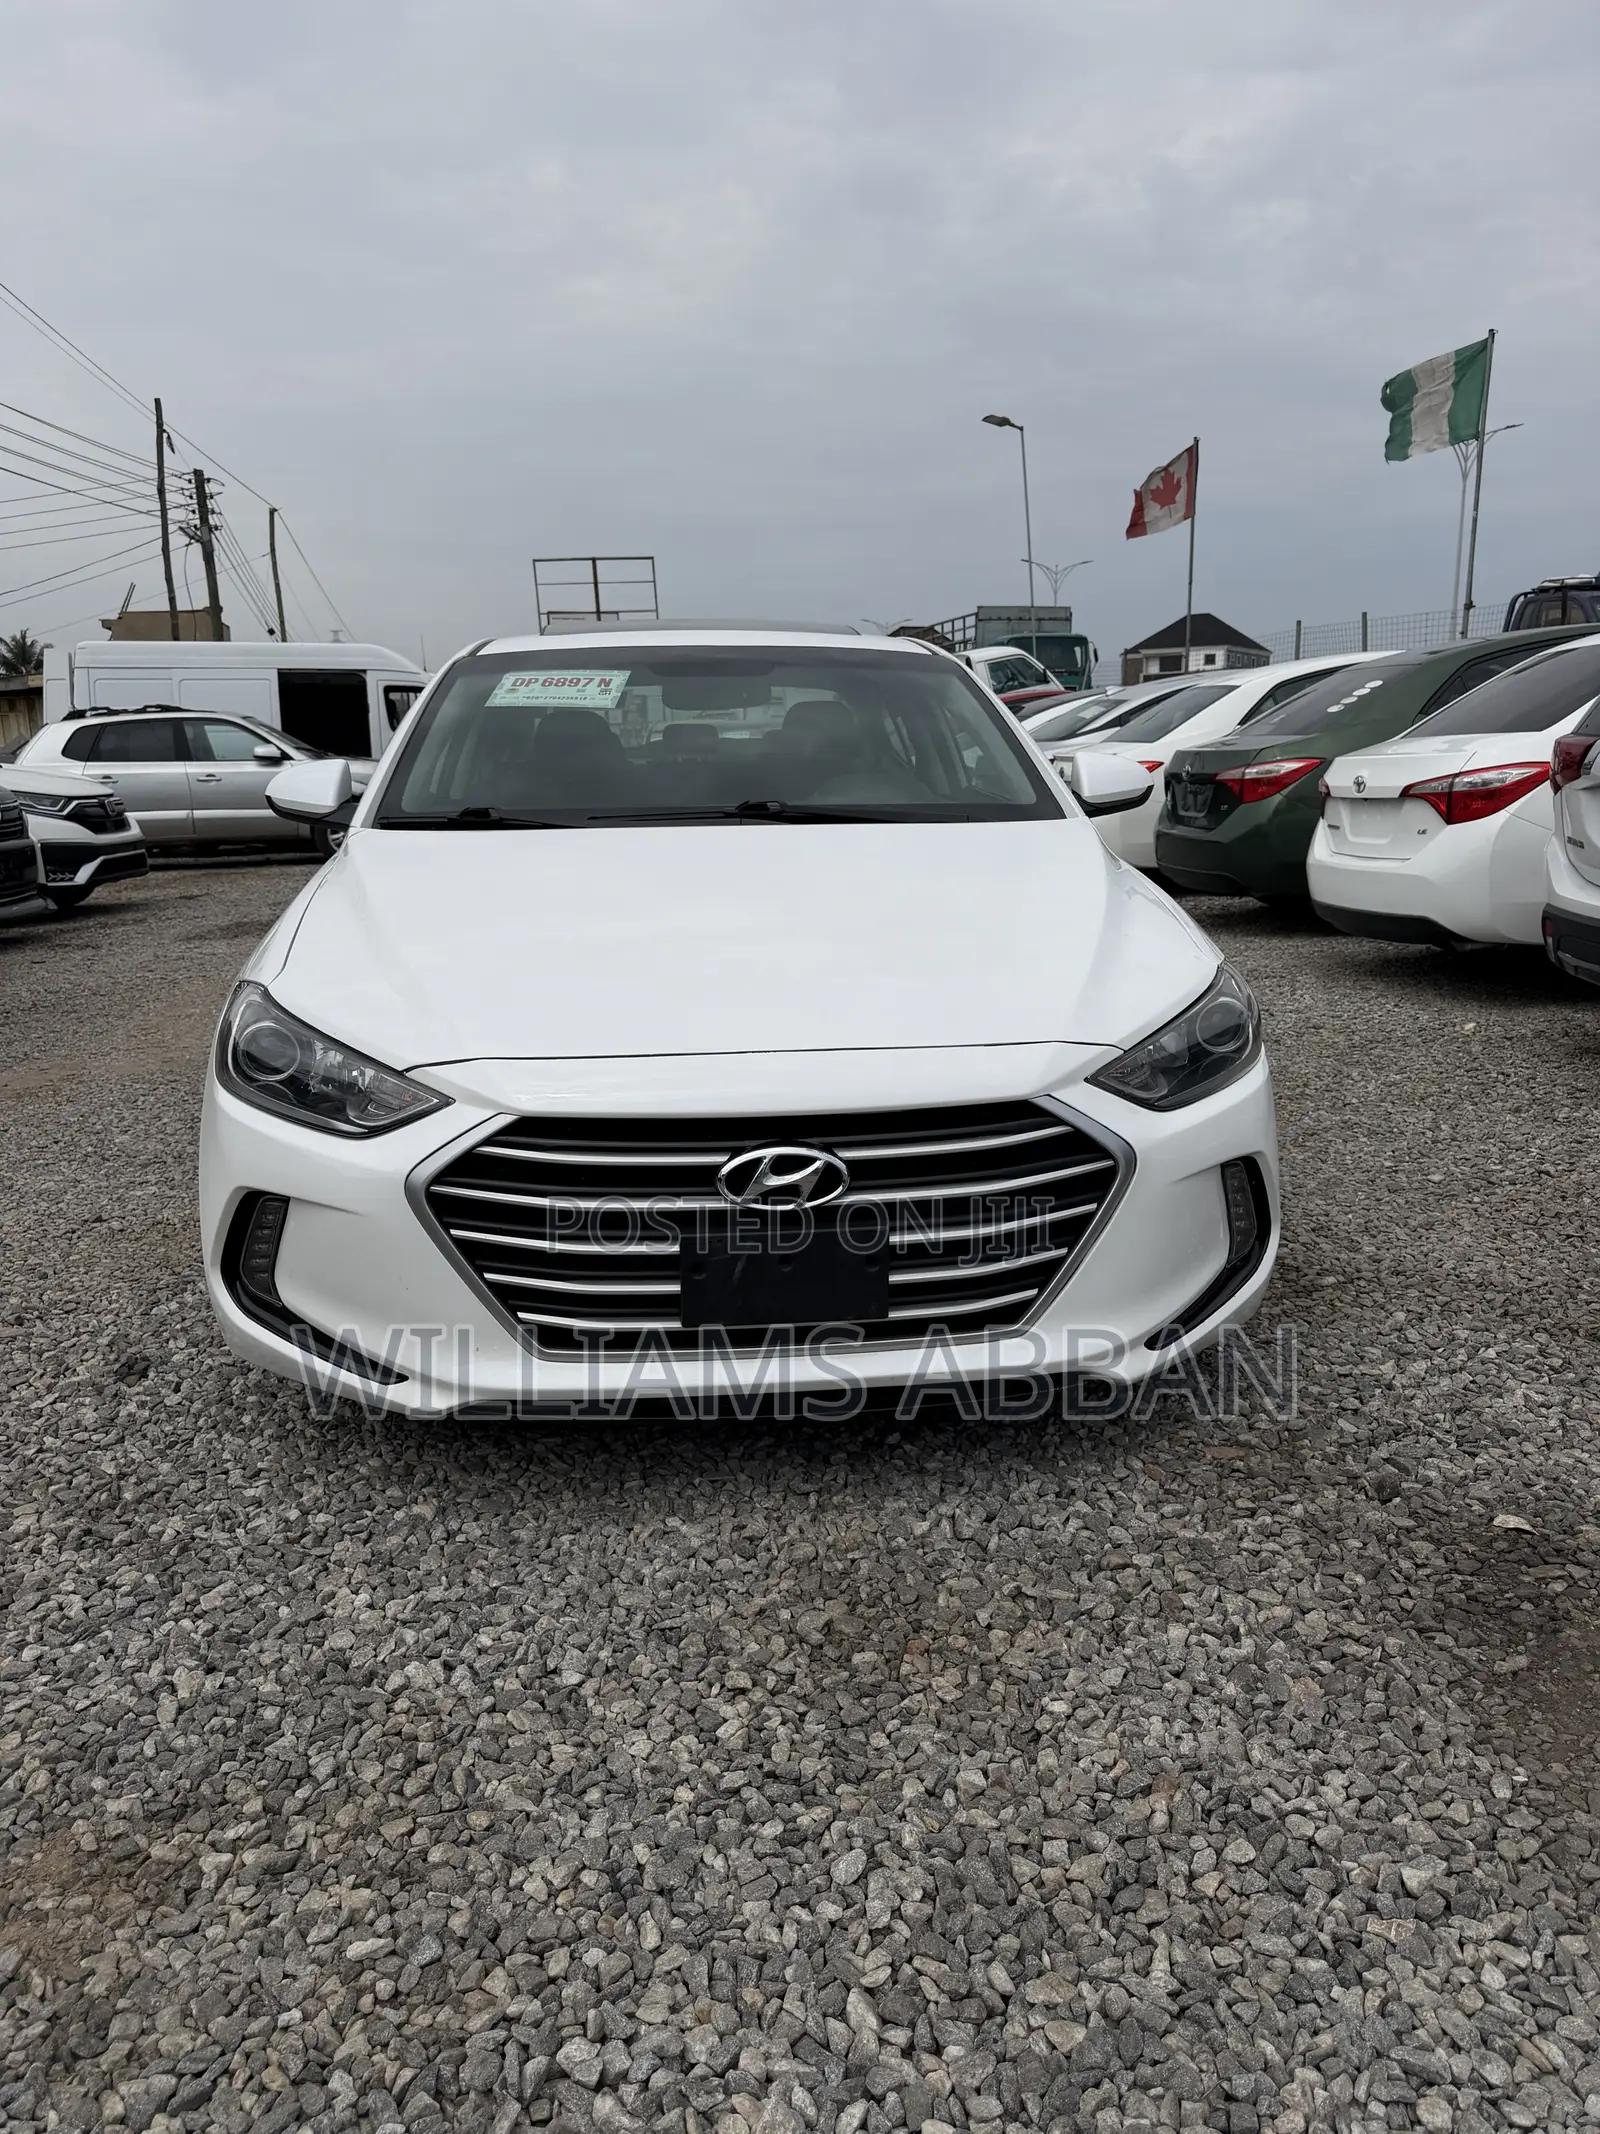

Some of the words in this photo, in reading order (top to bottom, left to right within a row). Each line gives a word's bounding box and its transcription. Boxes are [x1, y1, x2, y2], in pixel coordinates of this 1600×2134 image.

[510, 677, 540, 688] DP
[540, 677, 595, 688] 6897
[597, 677, 613, 688] N
